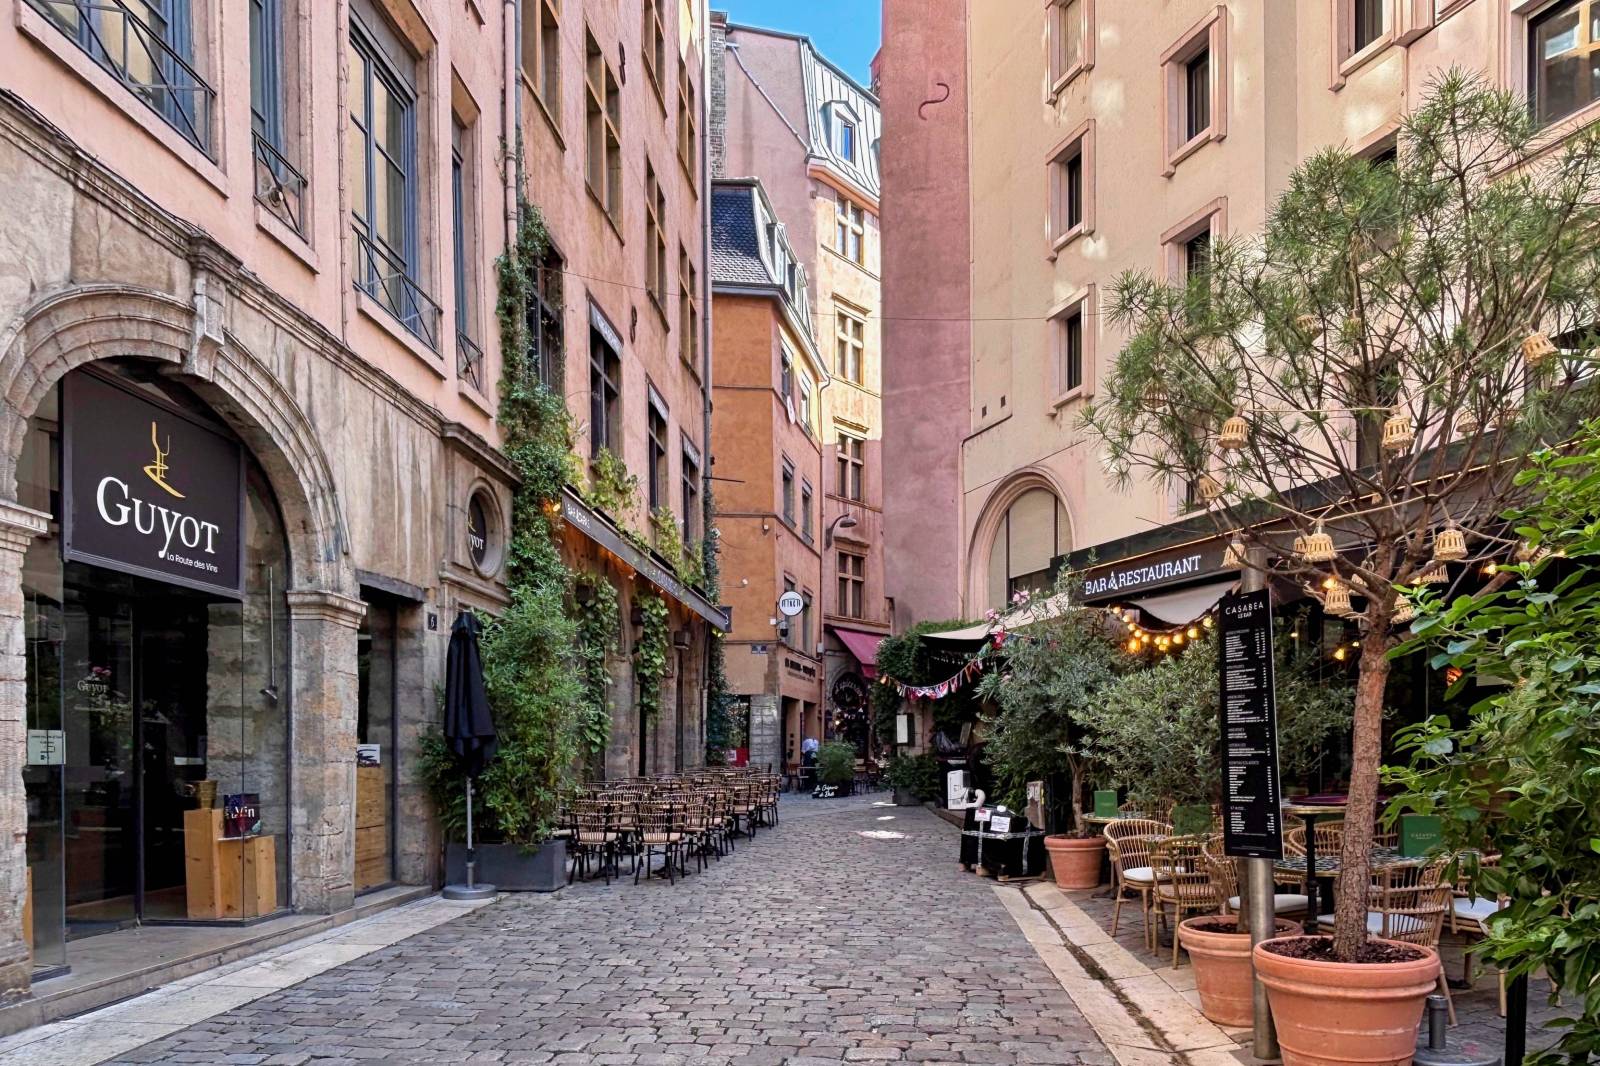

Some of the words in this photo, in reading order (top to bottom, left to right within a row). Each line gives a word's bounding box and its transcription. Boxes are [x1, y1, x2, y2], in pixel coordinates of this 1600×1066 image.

[96, 476, 219, 558] GUYOT
[470, 534, 484, 551] YOT
[175, 554, 193, 567] Route
[193, 560, 205, 570] des
[205, 562, 218, 573] Vins
[1085, 577, 1107, 595] BAR
[1118, 555, 1201, 588] RESTAURANT
[1225, 601, 1264, 615] CASABEA
[430, 616, 435, 628] 6
